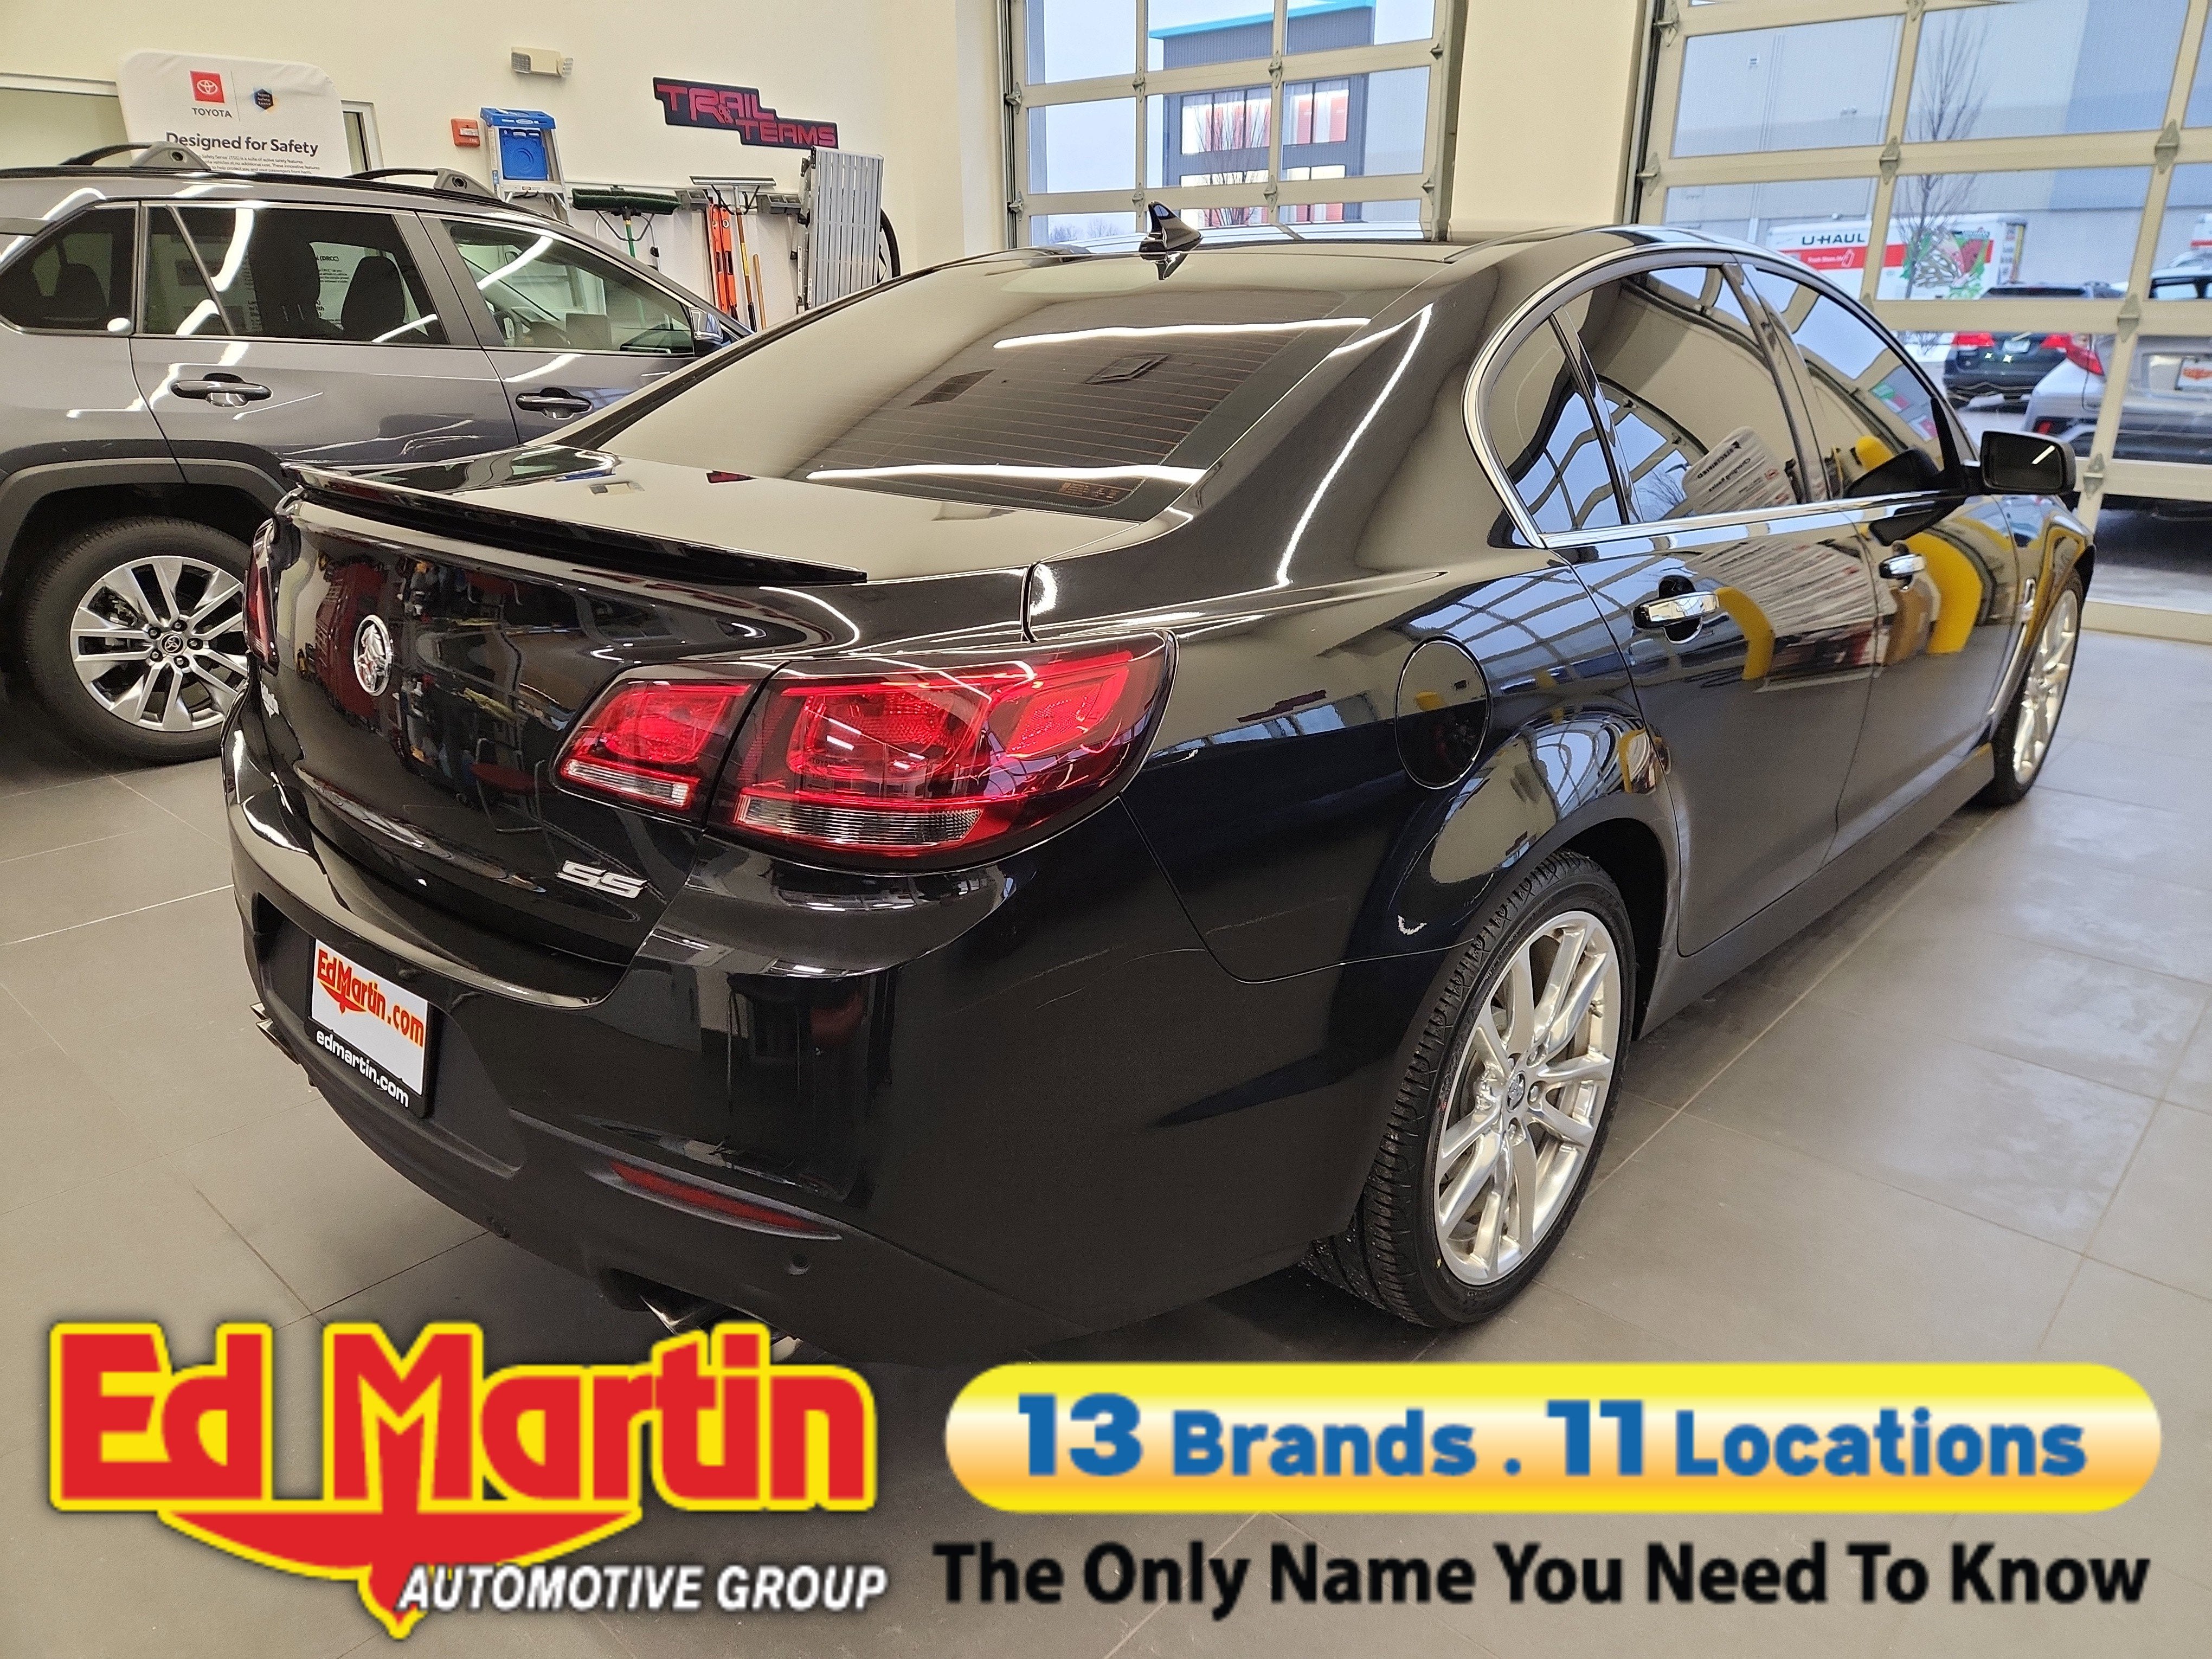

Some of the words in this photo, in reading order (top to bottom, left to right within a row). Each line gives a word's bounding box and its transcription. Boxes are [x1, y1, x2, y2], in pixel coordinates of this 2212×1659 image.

[191, 107, 233, 118] TOYOTA
[656, 83, 774, 124] TRAIL
[166, 132, 241, 151] Designed
[245, 136, 267, 150] for
[271, 139, 318, 157] Safety
[735, 118, 836, 146] TEAMS
[1802, 233, 1864, 245] U-HAUL
[556, 860, 648, 898] SS
[316, 1030, 409, 1108] edmartin.com
